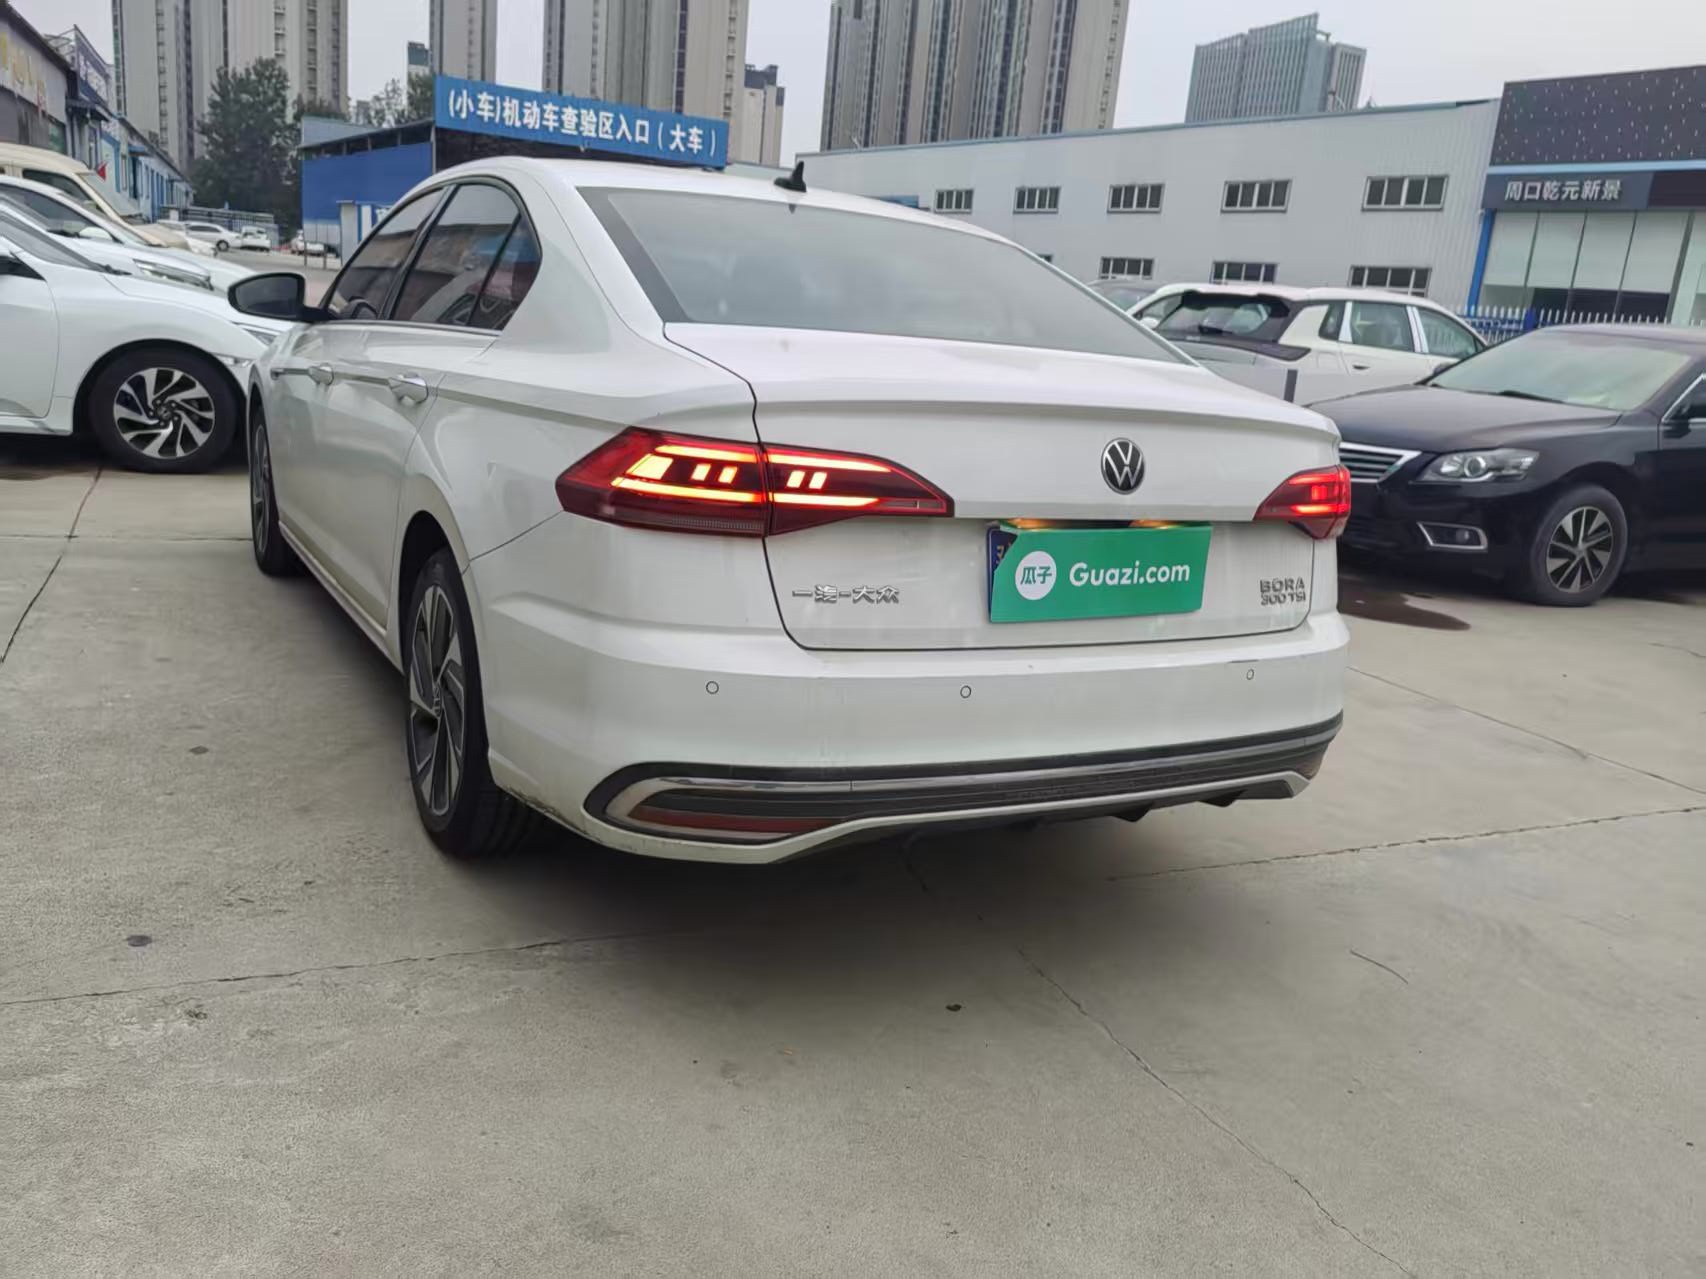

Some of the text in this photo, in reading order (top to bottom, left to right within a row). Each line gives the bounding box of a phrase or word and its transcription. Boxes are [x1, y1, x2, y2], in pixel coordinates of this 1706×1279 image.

[1020, 565, 1053, 585] 瓜子
[1069, 560, 1191, 587] Guazi.com
[1259, 576, 1305, 593] BORA
